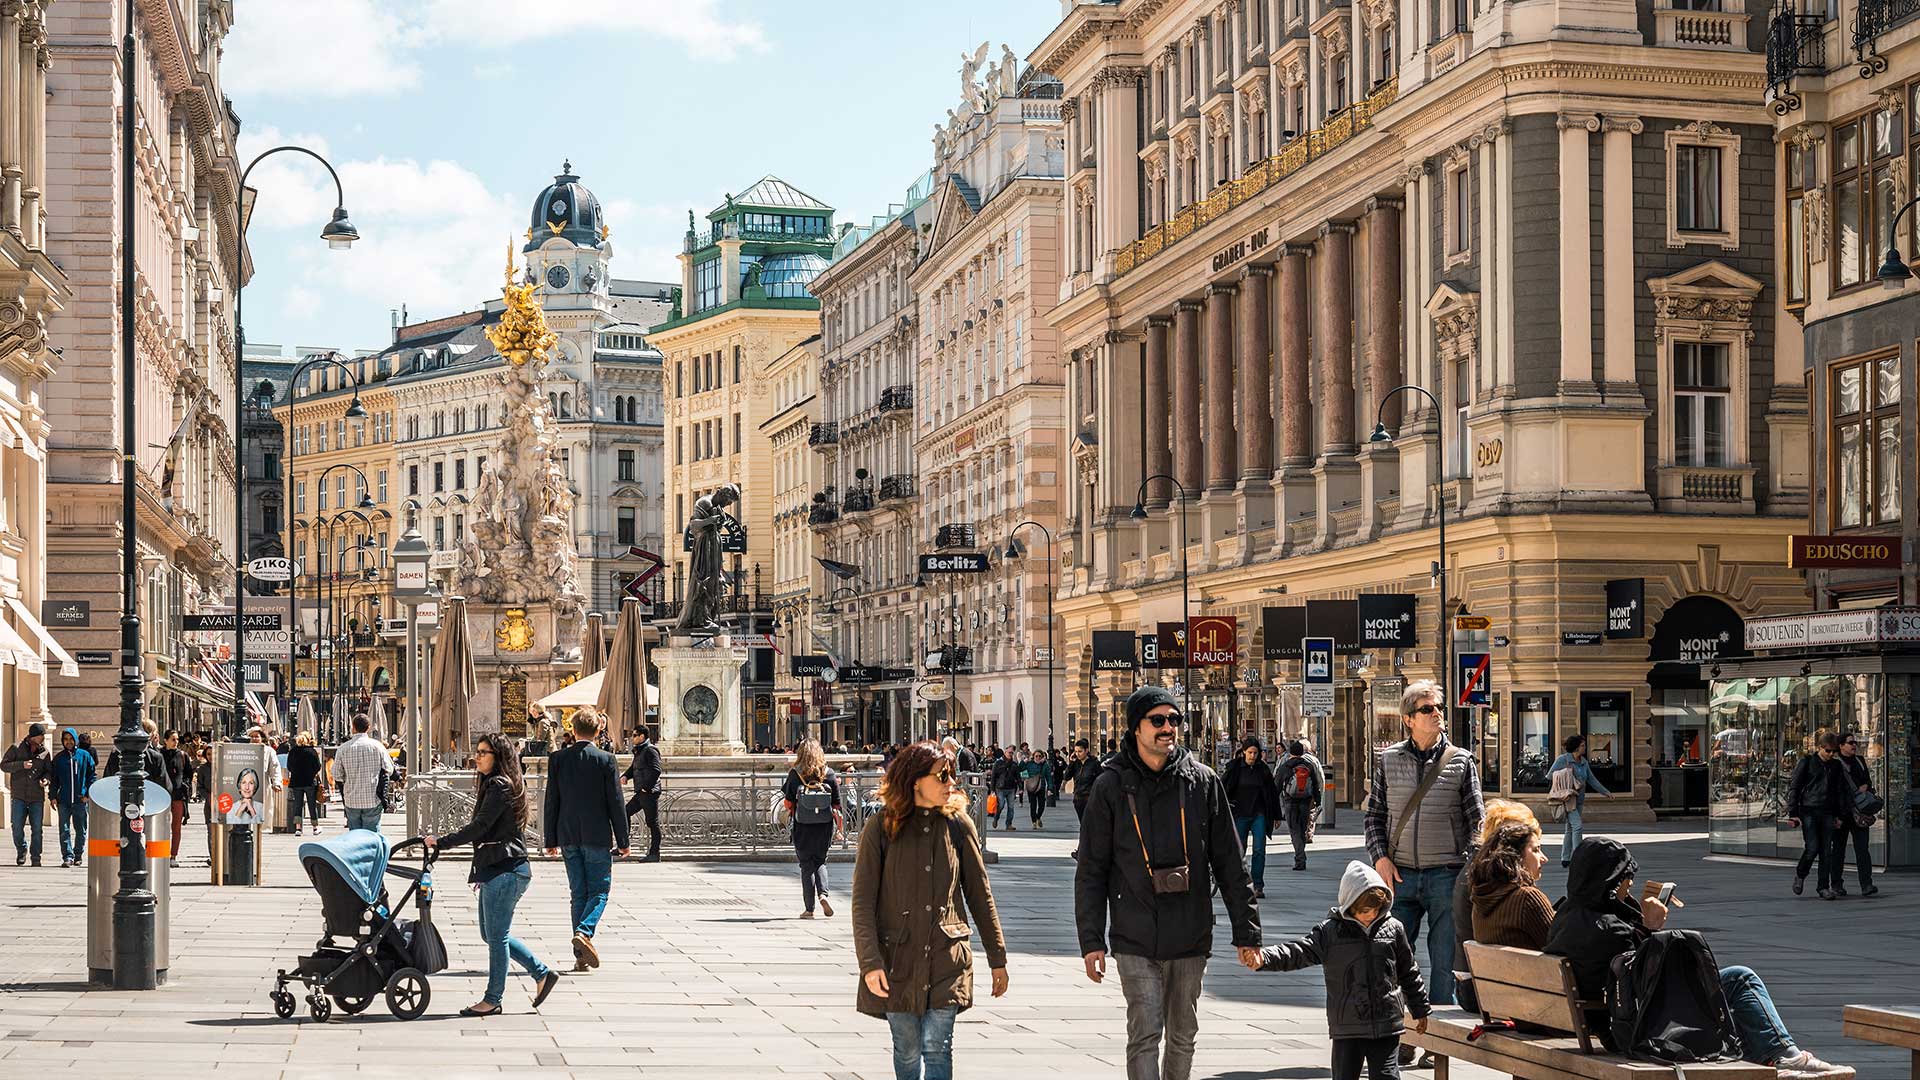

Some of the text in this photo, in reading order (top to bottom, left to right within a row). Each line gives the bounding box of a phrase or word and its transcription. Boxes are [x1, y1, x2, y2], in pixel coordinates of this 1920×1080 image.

[1212, 227, 1269, 272] GRABEN-HOF
[1805, 543, 1889, 560] EDUSCHO
[927, 556, 978, 570] Berlitz
[399, 572, 424, 580] DAMEN
[1610, 606, 1632, 619] MONT
[1365, 619, 1400, 629] MONT
[1610, 618, 1632, 630] BLANC
[1811, 623, 1840, 635] HOROWITZ
[1840, 623, 1845, 633] &
[1365, 630, 1401, 640] BLANC
[1756, 623, 1805, 642] SOUVENIRS
[1680, 638, 1719, 651] MONT
[1193, 651, 1234, 662] RAUCH
[1098, 659, 1132, 668] MaxMara
